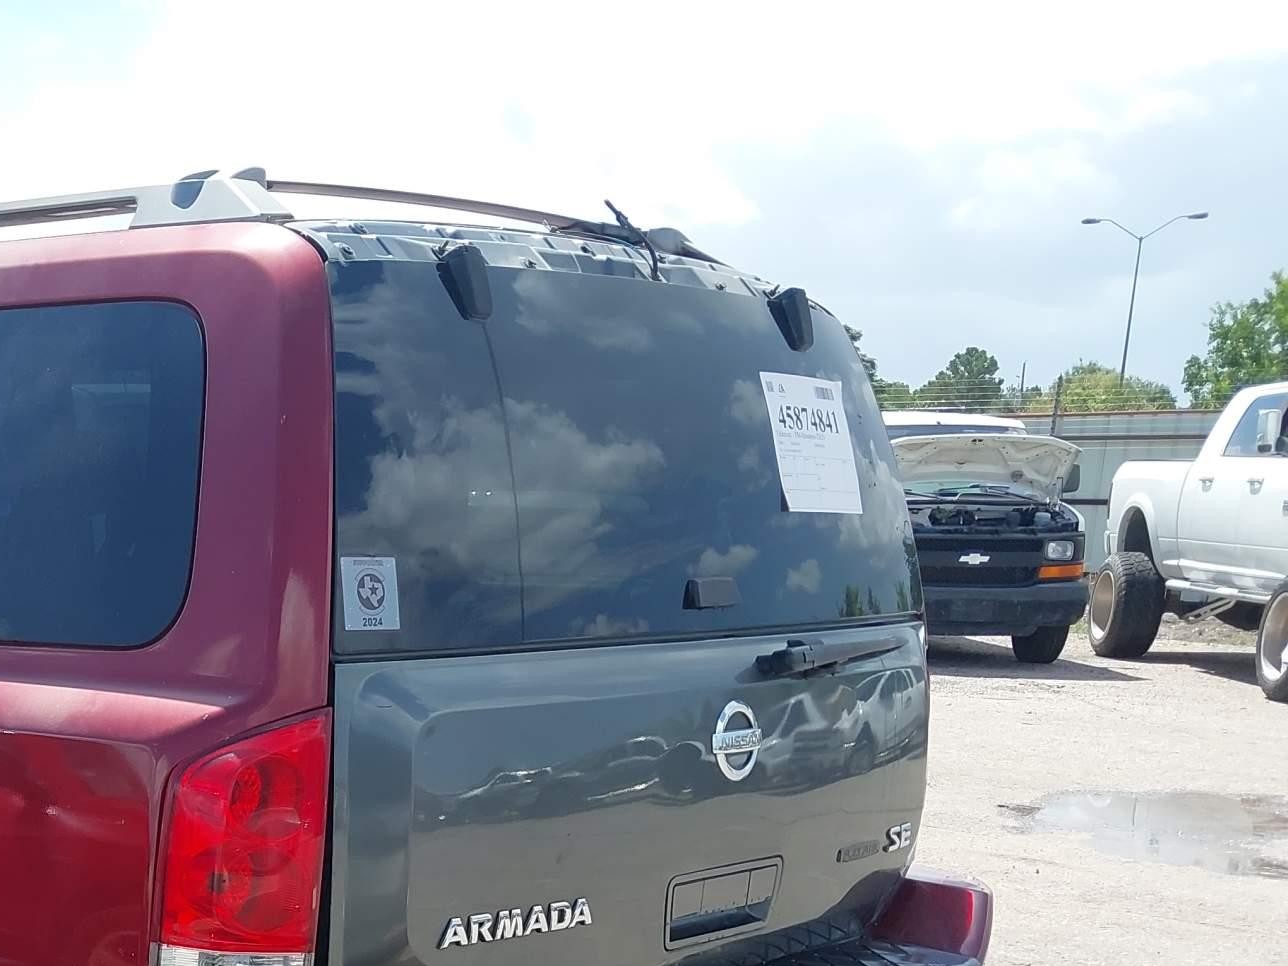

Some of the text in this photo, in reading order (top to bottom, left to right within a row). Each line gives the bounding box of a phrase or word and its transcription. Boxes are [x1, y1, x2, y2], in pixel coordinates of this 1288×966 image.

[778, 404, 840, 434] 45874841
[362, 617, 383, 627] 2024
[883, 822, 911, 853] SE
[437, 898, 592, 949] ARMADA
